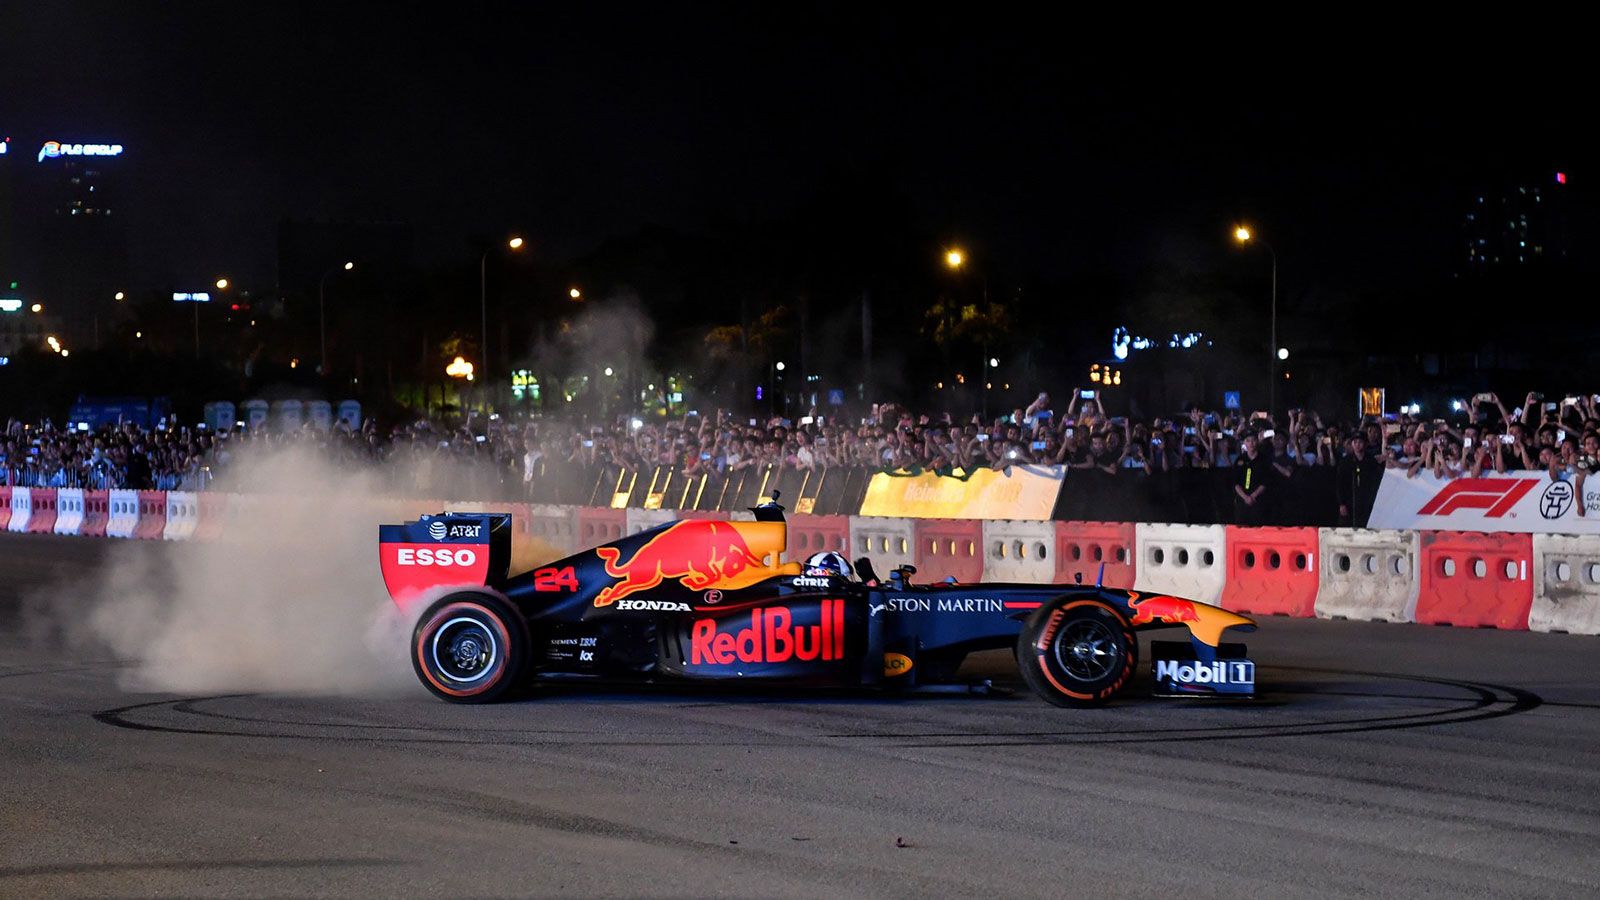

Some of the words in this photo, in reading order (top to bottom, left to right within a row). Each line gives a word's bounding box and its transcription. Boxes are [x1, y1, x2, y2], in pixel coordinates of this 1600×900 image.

[83, 144, 122, 156] GROUP
[449, 525, 481, 538] AT&T
[397, 549, 476, 567] ESSO
[534, 566, 579, 592] 24
[616, 600, 692, 612] HONDA
[937, 598, 1002, 612] MARTIN
[579, 637, 597, 647] IBM
[1156, 660, 1226, 684] Mobil
